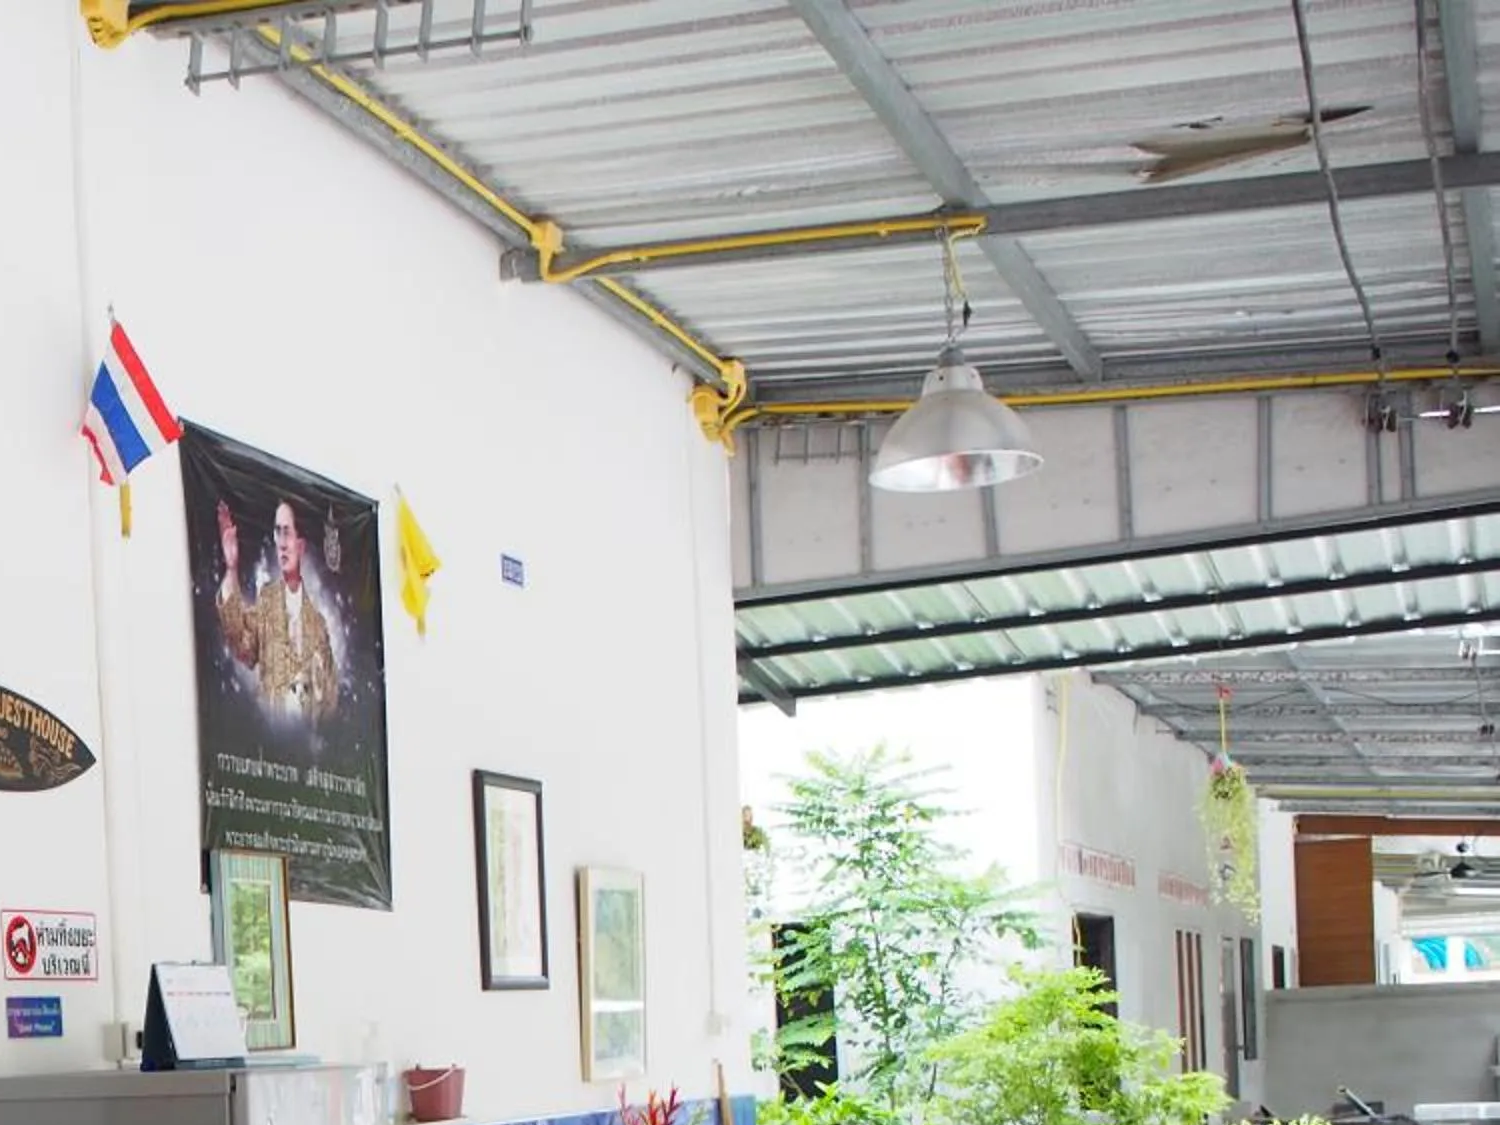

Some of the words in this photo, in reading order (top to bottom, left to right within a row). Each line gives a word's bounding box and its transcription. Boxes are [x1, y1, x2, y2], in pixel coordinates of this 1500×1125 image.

[36, 918, 96, 947] ห้ามทิ้งขยะ
